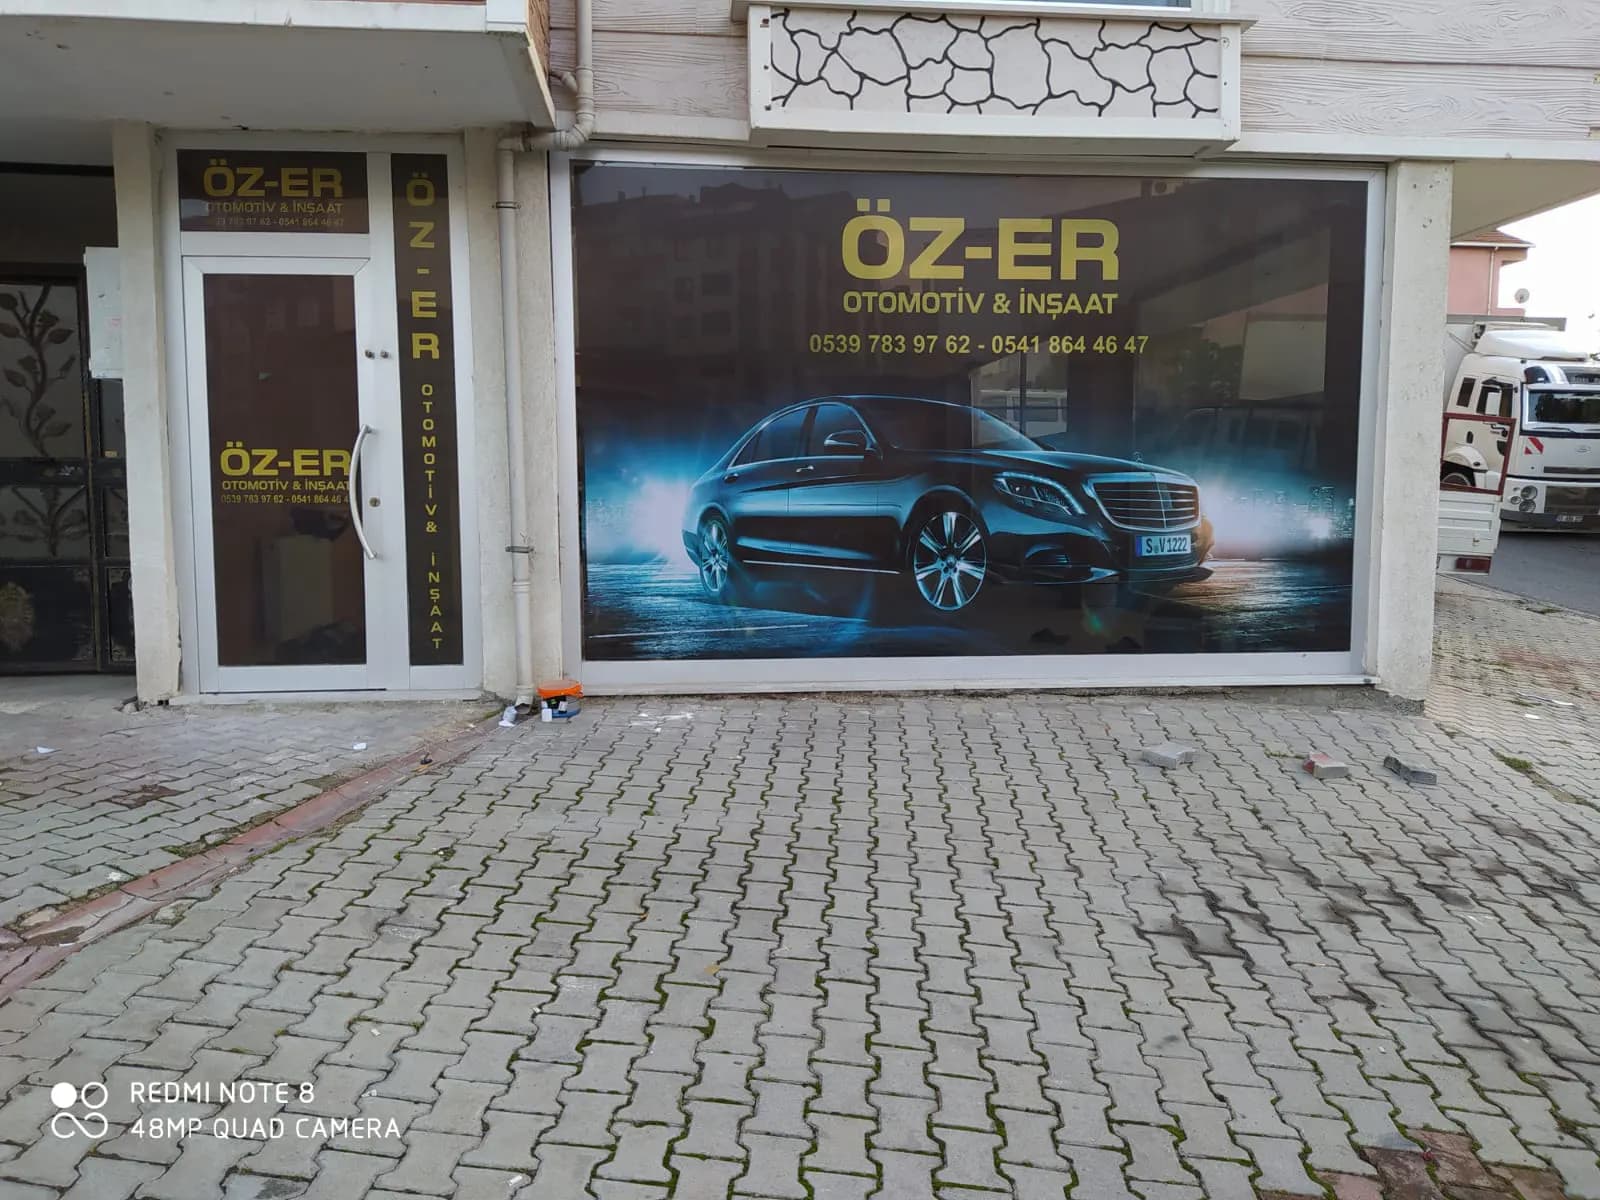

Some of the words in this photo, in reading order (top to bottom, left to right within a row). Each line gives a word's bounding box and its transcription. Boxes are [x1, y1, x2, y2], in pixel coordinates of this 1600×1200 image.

[203, 158, 343, 197] ÖZ-ER
[207, 200, 276, 213] OTOMOTİV
[279, 203, 289, 213] &
[842, 198, 1119, 281] ÖZ-ER
[843, 287, 985, 314] OTOMOTİV
[993, 291, 1010, 314] &
[1019, 288, 1119, 320] İNŞAAT
[809, 335, 861, 353] 0539
[869, 335, 906, 353] 783
[913, 336, 938, 353] 97
[945, 336, 970, 354] 62
[991, 336, 1040, 354] 0541
[1048, 336, 1086, 354] 864
[1093, 337, 1117, 354] 46
[1124, 336, 1149, 354] 47
[220, 441, 350, 476] ÖZ-ER
[222, 479, 288, 491] OTOMOTİV
[292, 481, 302, 491] &
[261, 495, 271, 504] 97
[292, 495, 312, 504] 0541
[314, 495, 329, 504] 864
